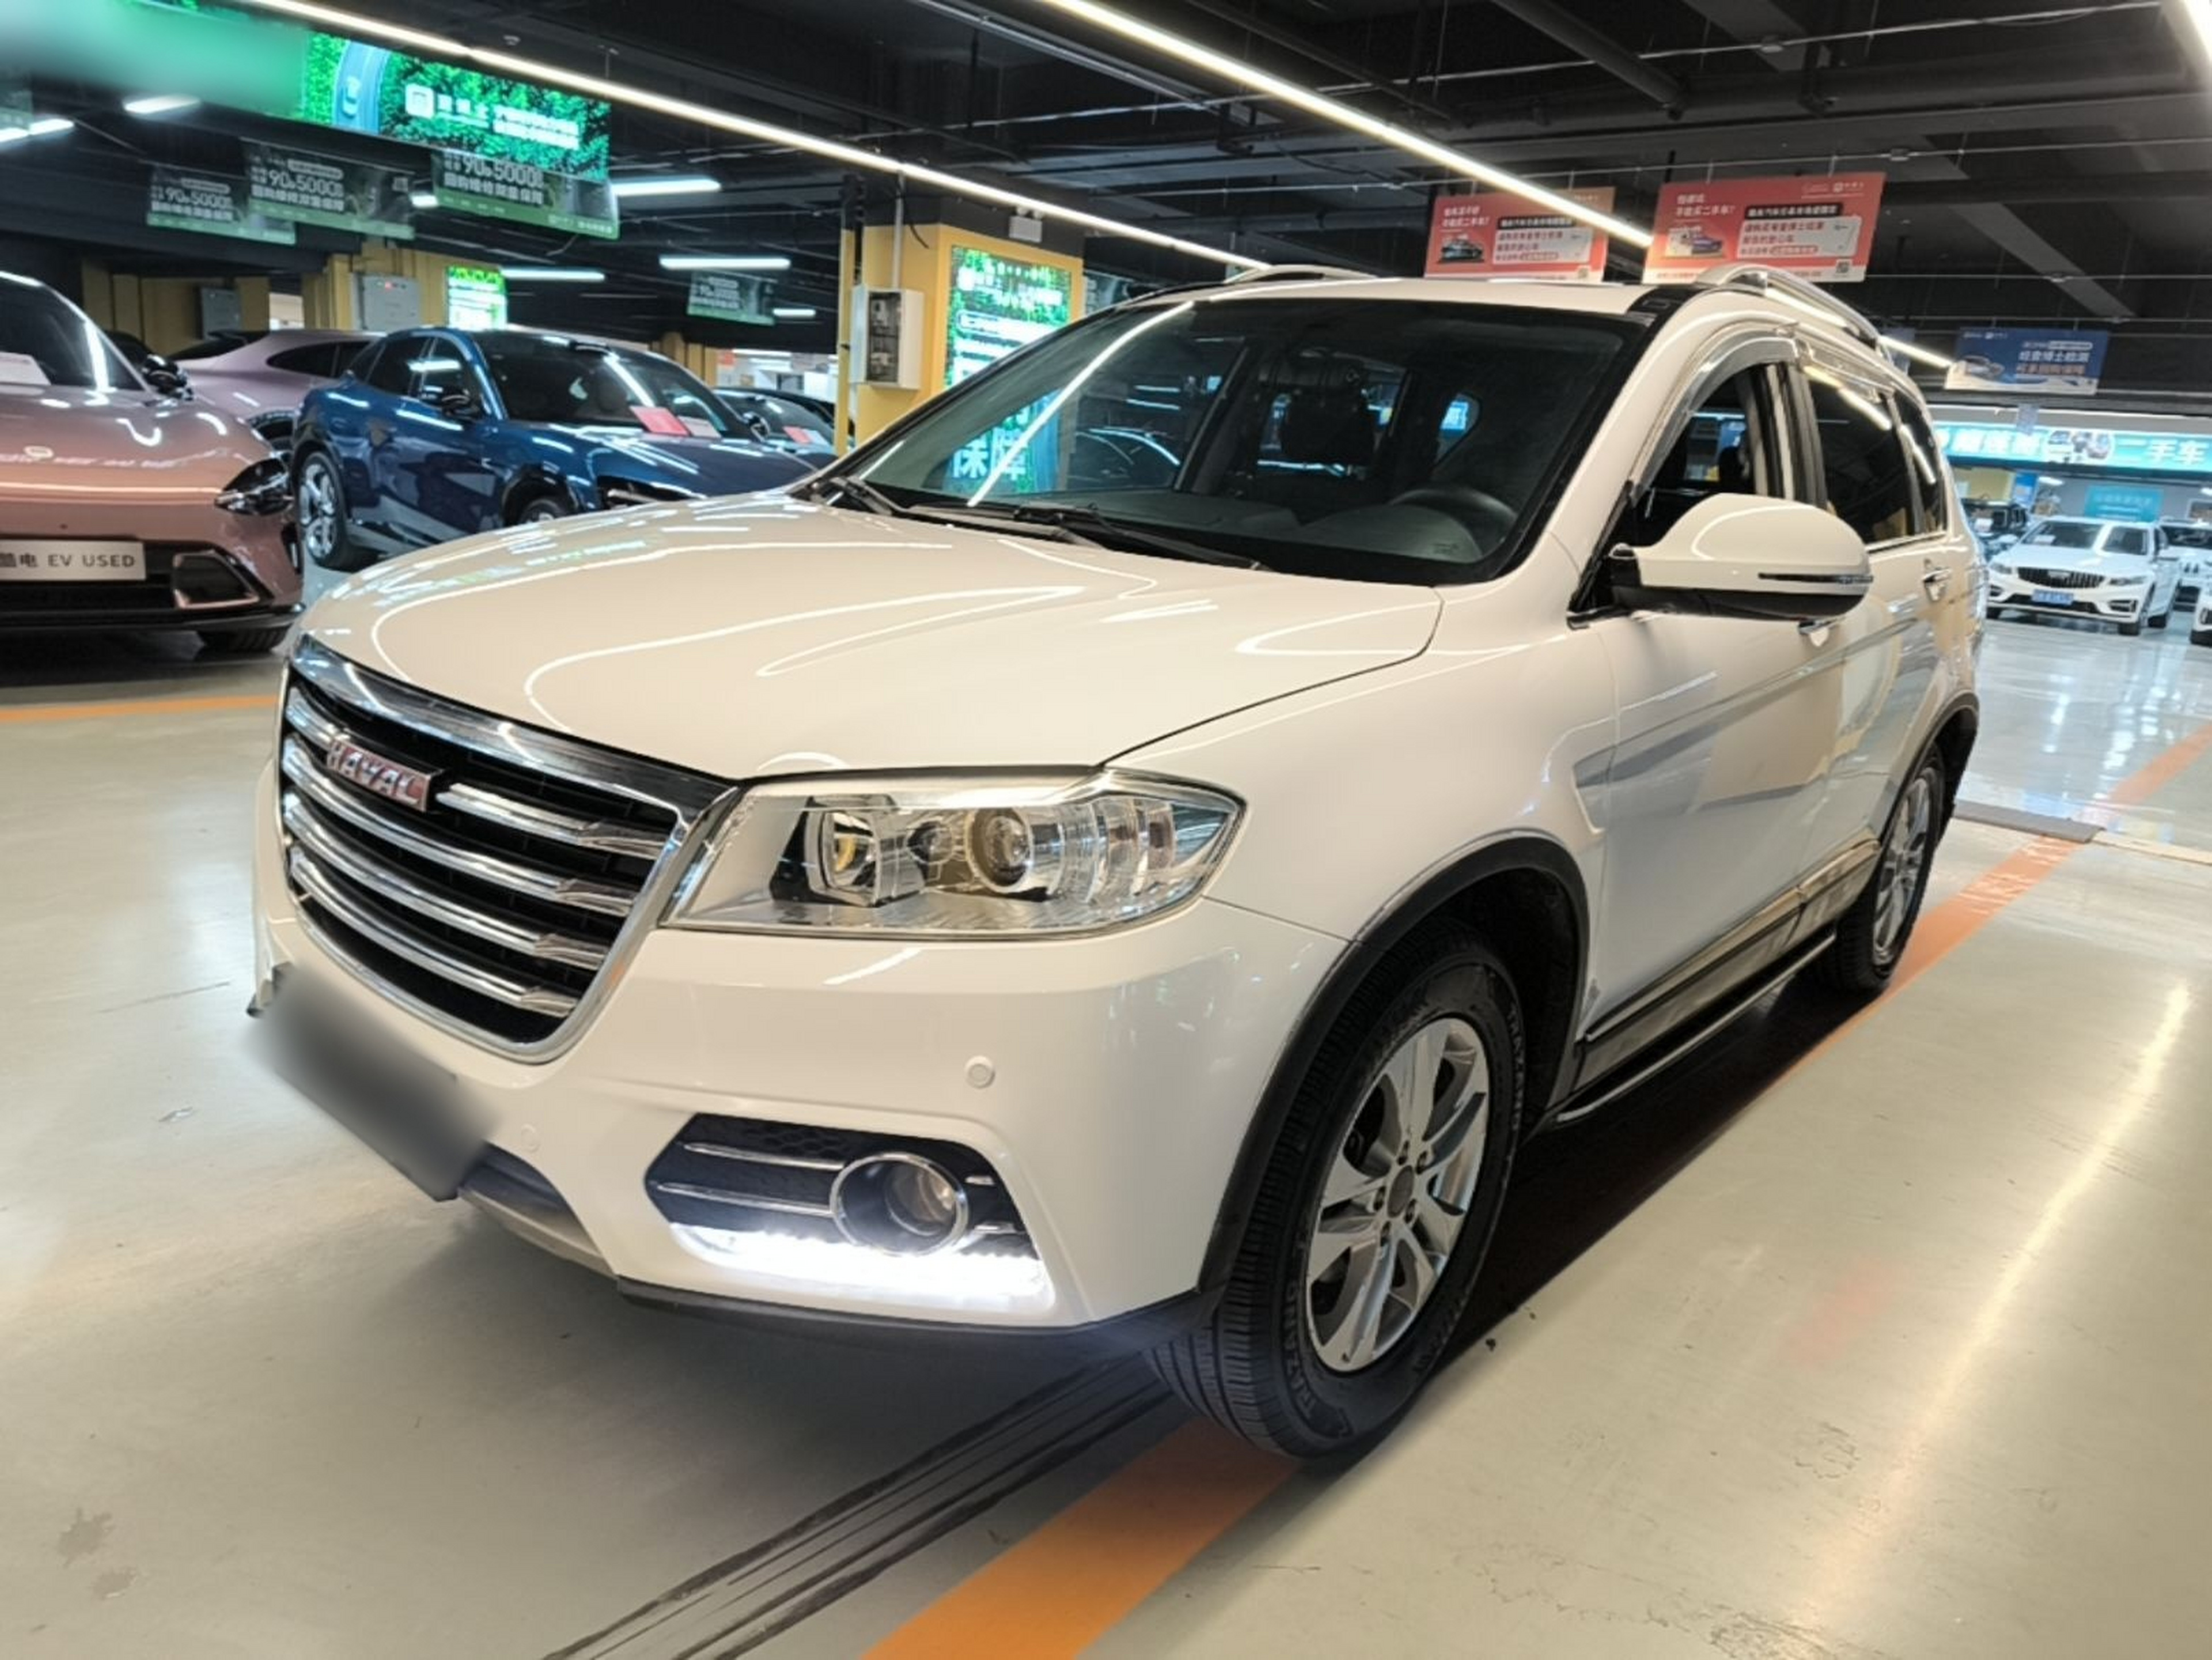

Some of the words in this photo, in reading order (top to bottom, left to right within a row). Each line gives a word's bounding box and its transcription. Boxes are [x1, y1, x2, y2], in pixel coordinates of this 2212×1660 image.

[2117, 437, 2209, 466] 二手车
[47, 554, 73, 568] EV
[82, 554, 136, 568] USED
[326, 739, 429, 808] HAVAL
